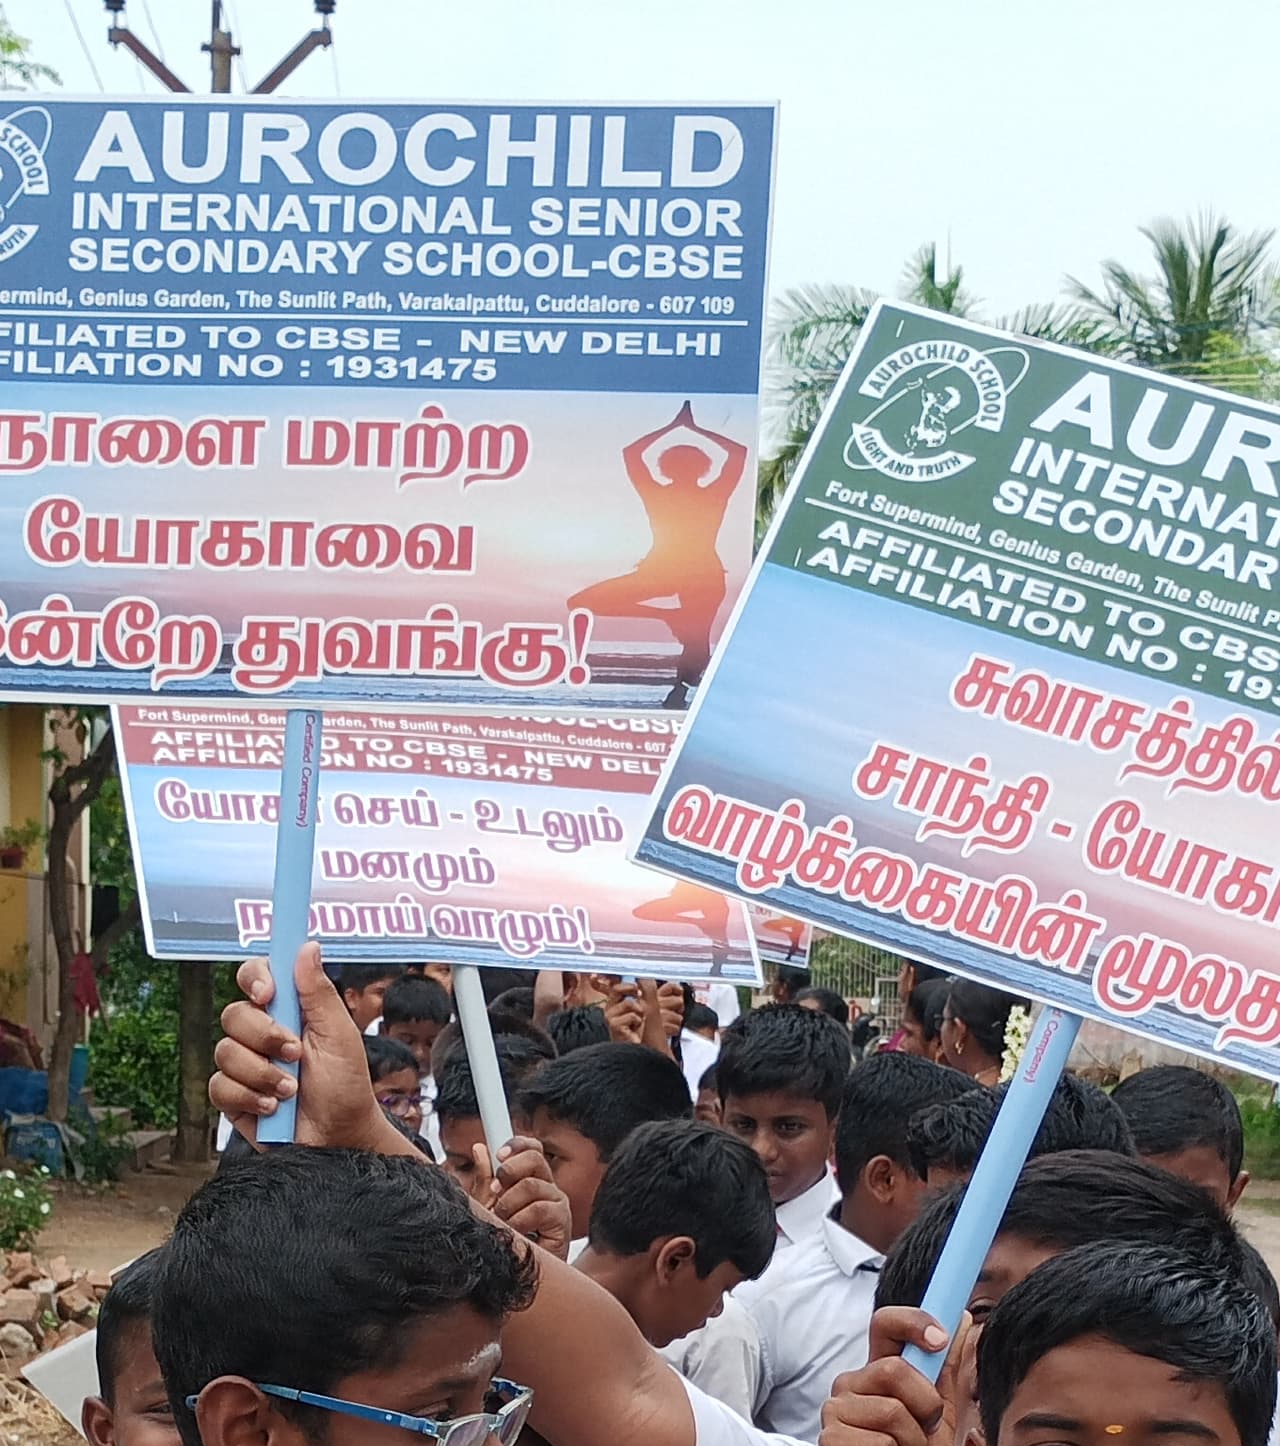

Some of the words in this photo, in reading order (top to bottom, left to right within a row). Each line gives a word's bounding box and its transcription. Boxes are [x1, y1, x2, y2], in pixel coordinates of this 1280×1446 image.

[0, 127, 43, 187] SCHOOL
[74, 110, 744, 188] AUROCHILD
[71, 193, 512, 236] INTERNATIONAL
[529, 197, 743, 238] SENIOR
[68, 238, 373, 276] SECONDARY
[382, 241, 744, 280] SCHOOL-CBSE
[79, 287, 148, 308] Genius
[153, 288, 231, 311] Garden,
[236, 289, 274, 309] The
[279, 290, 336, 310] Sunlit
[342, 291, 392, 313] Path,
[399, 292, 529, 316] Varakalpattu,
[536, 294, 640, 314] Cuddalore
[660, 295, 695, 314] 607
[701, 296, 734, 315] 109
[201, 326, 261, 349] TO
[276, 327, 401, 351] CBSE
[460, 329, 568, 354] NEW
[581, 331, 720, 356] DELHI
[219, 353, 284, 377] NO
[300, 359, 310, 377] :
[326, 356, 497, 381] 1931475
[869, 344, 970, 393] AUROCHILD
[970, 359, 1001, 422] SCHOOL
[284, 403, 530, 488] மாற்ற
[860, 432, 887, 468] LIGHT
[884, 459, 914, 476] AND
[919, 456, 960, 476] TRUTH
[26, 498, 475, 572] யோகாவை
[826, 481, 867, 508] Fort
[871, 494, 982, 543] Supermind,
[989, 530, 1060, 564] Genius
[1066, 551, 1144, 592] Garden,
[1153, 575, 1190, 603] The
[1195, 588, 1260, 624] Sunlit
[819, 520, 1086, 614] AFFILIATED
[1103, 600, 1165, 636] TO
[807, 547, 1094, 650] AFFILIATION
[1105, 634, 1178, 671] NO
[1192, 663, 1207, 681] :
[234, 604, 591, 689] துவங்கு!
[138, 709, 168, 721] Fort
[172, 710, 254, 725] Supermind,
[258, 713, 286, 724] Gen
[323, 715, 366, 729] arden,
[370, 717, 395, 729] The
[399, 719, 439, 732] Sunlit
[442, 722, 476, 737] Path,
[479, 726, 564, 745] Varakalpattu,
[567, 735, 633, 750] Cuddalore
[644, 741, 666, 753] 607
[151, 731, 340, 752] AFFILIAD
[349, 736, 400, 752] TO
[403, 739, 487, 760] CBSE
[525, 750, 593, 769] NEW
[602, 758, 662, 776] DEL
[296, 767, 312, 828] Company)
[366, 753, 413, 769] NO
[441, 760, 553, 782] 1931475
[334, 790, 439, 826] செய்
[476, 800, 624, 851] உடலும்
[856, 743, 1050, 855] சாந்தி
[323, 848, 495, 890] மனமும்
[666, 786, 1104, 970] வாழ்க்கையின்
[238, 897, 426, 943] நமாய்
[434, 906, 592, 955] வாழும்!
[1024, 1021, 1059, 1083] Company)
